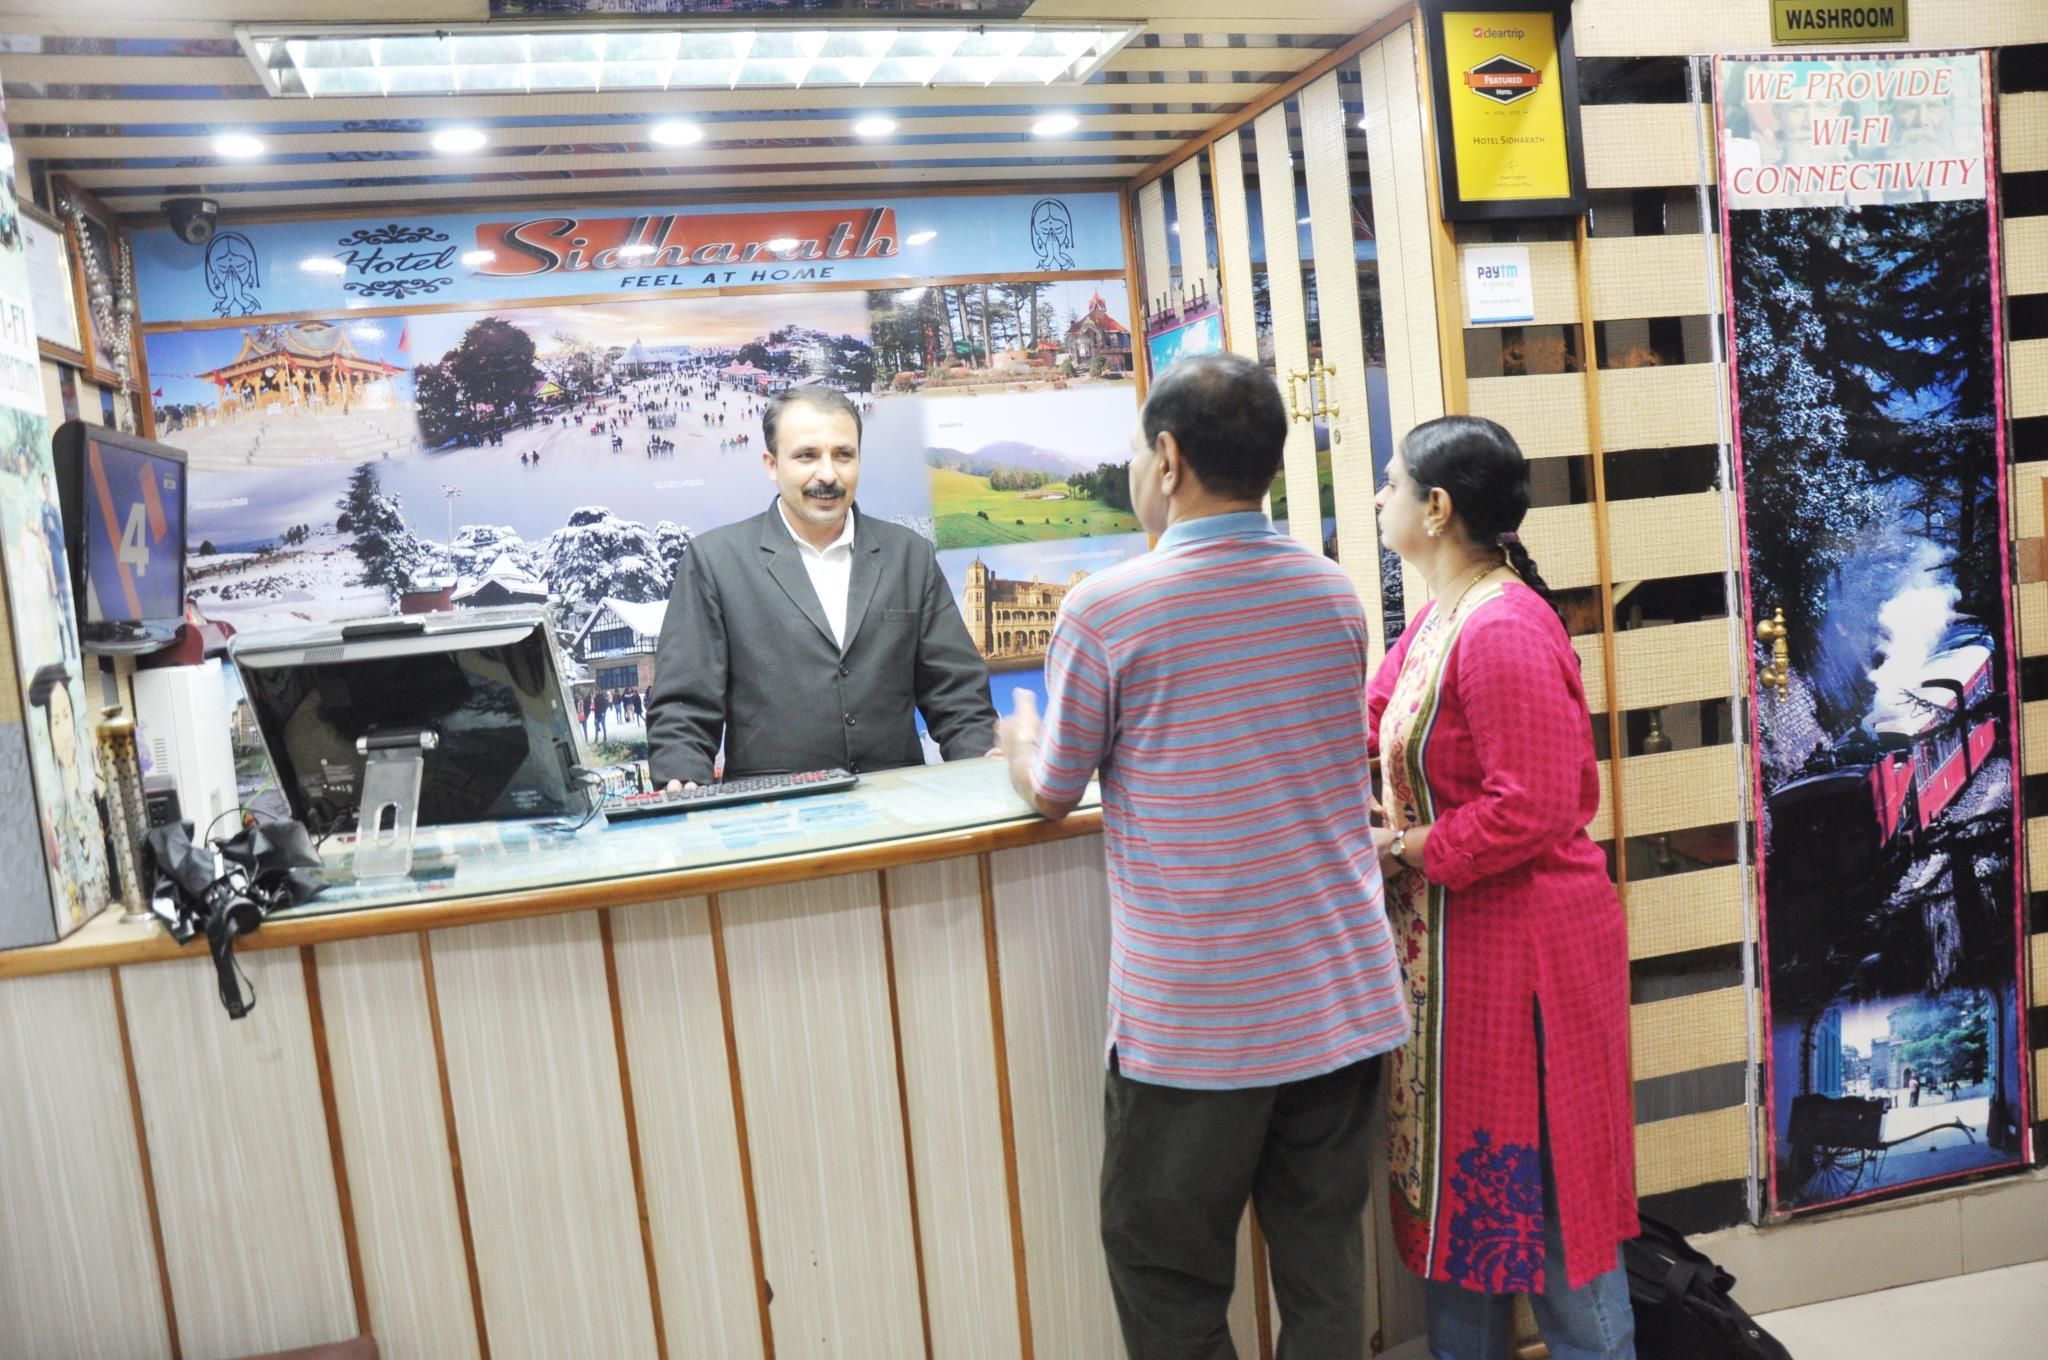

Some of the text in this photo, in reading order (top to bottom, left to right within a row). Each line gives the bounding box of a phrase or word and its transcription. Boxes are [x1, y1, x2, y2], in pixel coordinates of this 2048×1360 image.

[1786, 7, 1894, 30] WASHROOM
[1483, 28, 1525, 40] cleartrip
[1747, 68, 1952, 100] WE PROVIDE
[1812, 117, 1891, 146] WI-FI
[1733, 158, 1978, 195] CONNECTIVITY
[334, 206, 900, 277] Hotel Sidharath
[620, 266, 835, 288] FEEL AT HOME
[119, 502, 150, 577] 4
